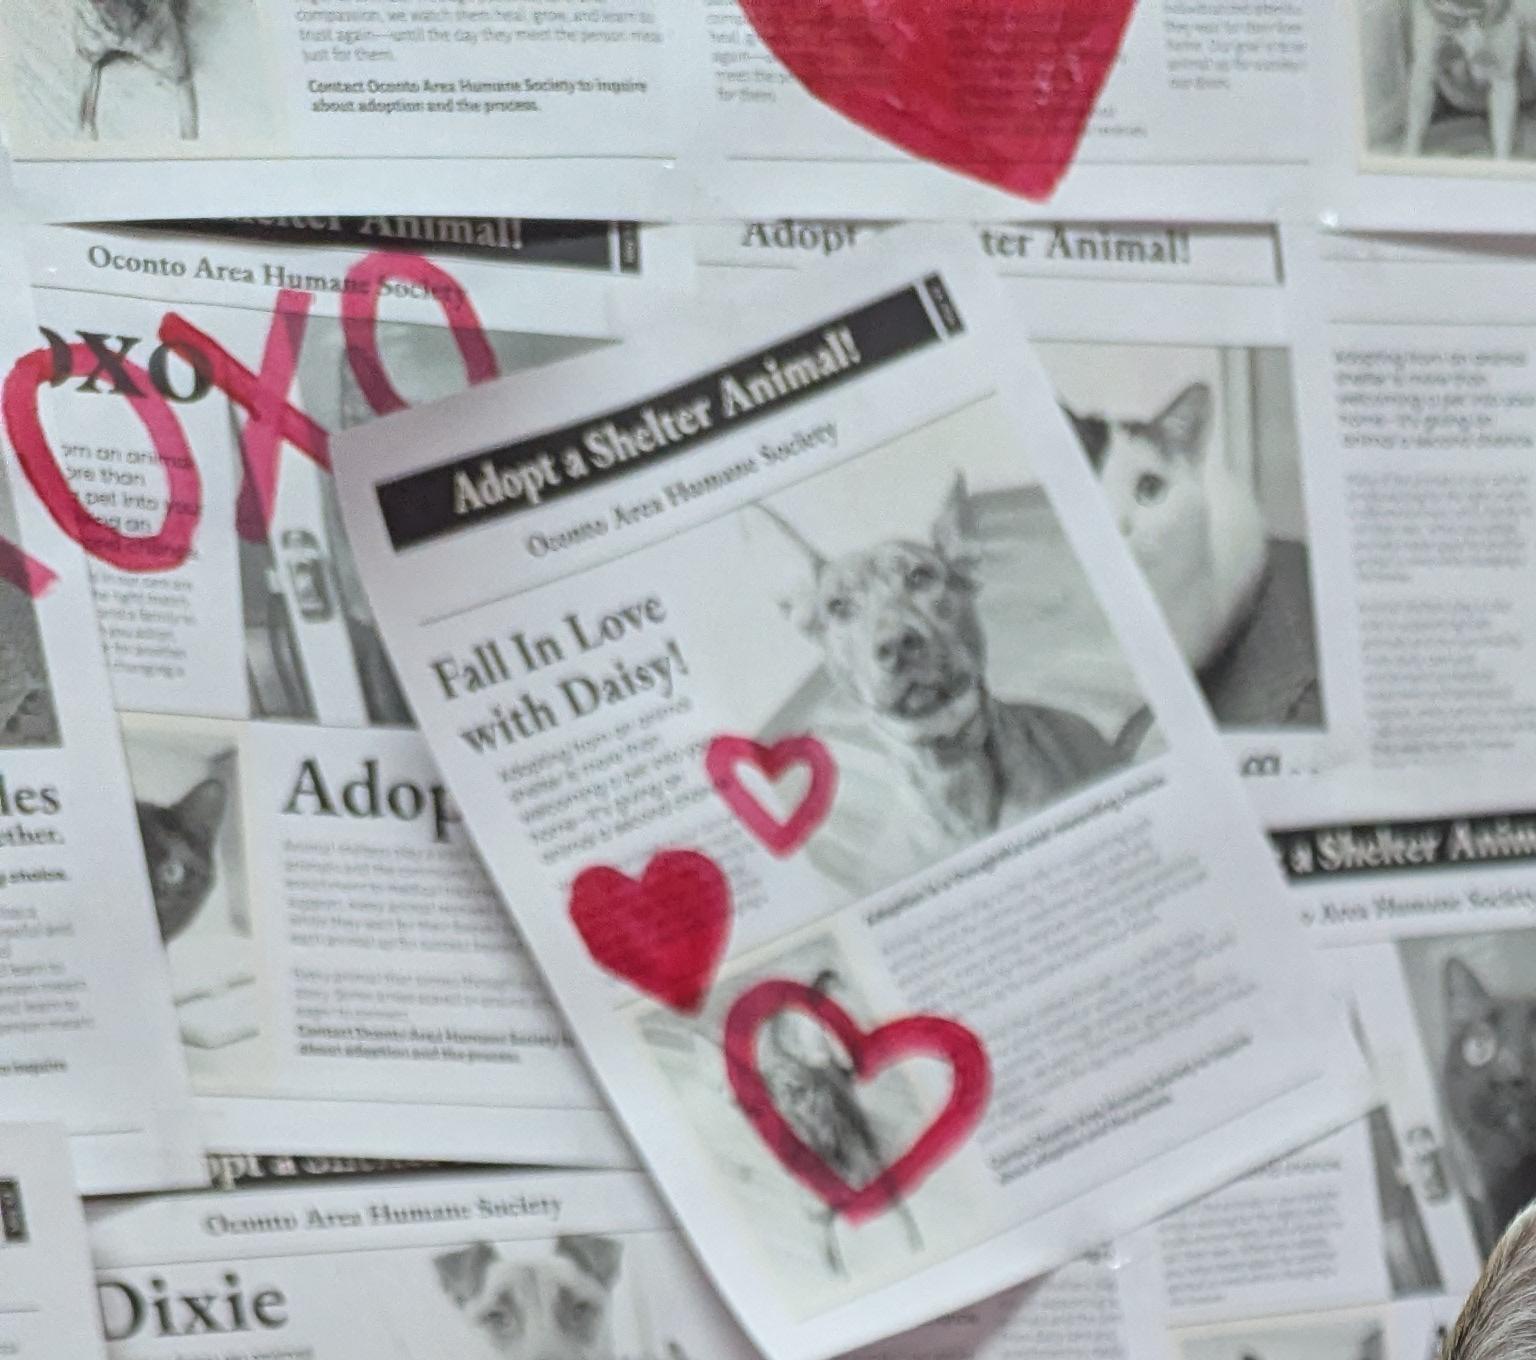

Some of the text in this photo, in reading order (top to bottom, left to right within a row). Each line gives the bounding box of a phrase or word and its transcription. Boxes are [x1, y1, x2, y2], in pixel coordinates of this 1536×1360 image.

[308, 79, 364, 93] Contact
[741, 218, 858, 256] Adopt
[88, 245, 468, 312] Oconto Area Humane Society
[0, 248, 500, 600] OXO
[452, 327, 863, 516] Adopt a Shelter Animal!
[757, 418, 840, 474] Society
[430, 596, 669, 702] Fall In Love
[458, 638, 690, 756] with Daisy!
[1316, 828, 1440, 873] Shelter
[206, 1193, 564, 1237] Oconto Area Humane Society
[98, 1271, 290, 1343] Dixie
